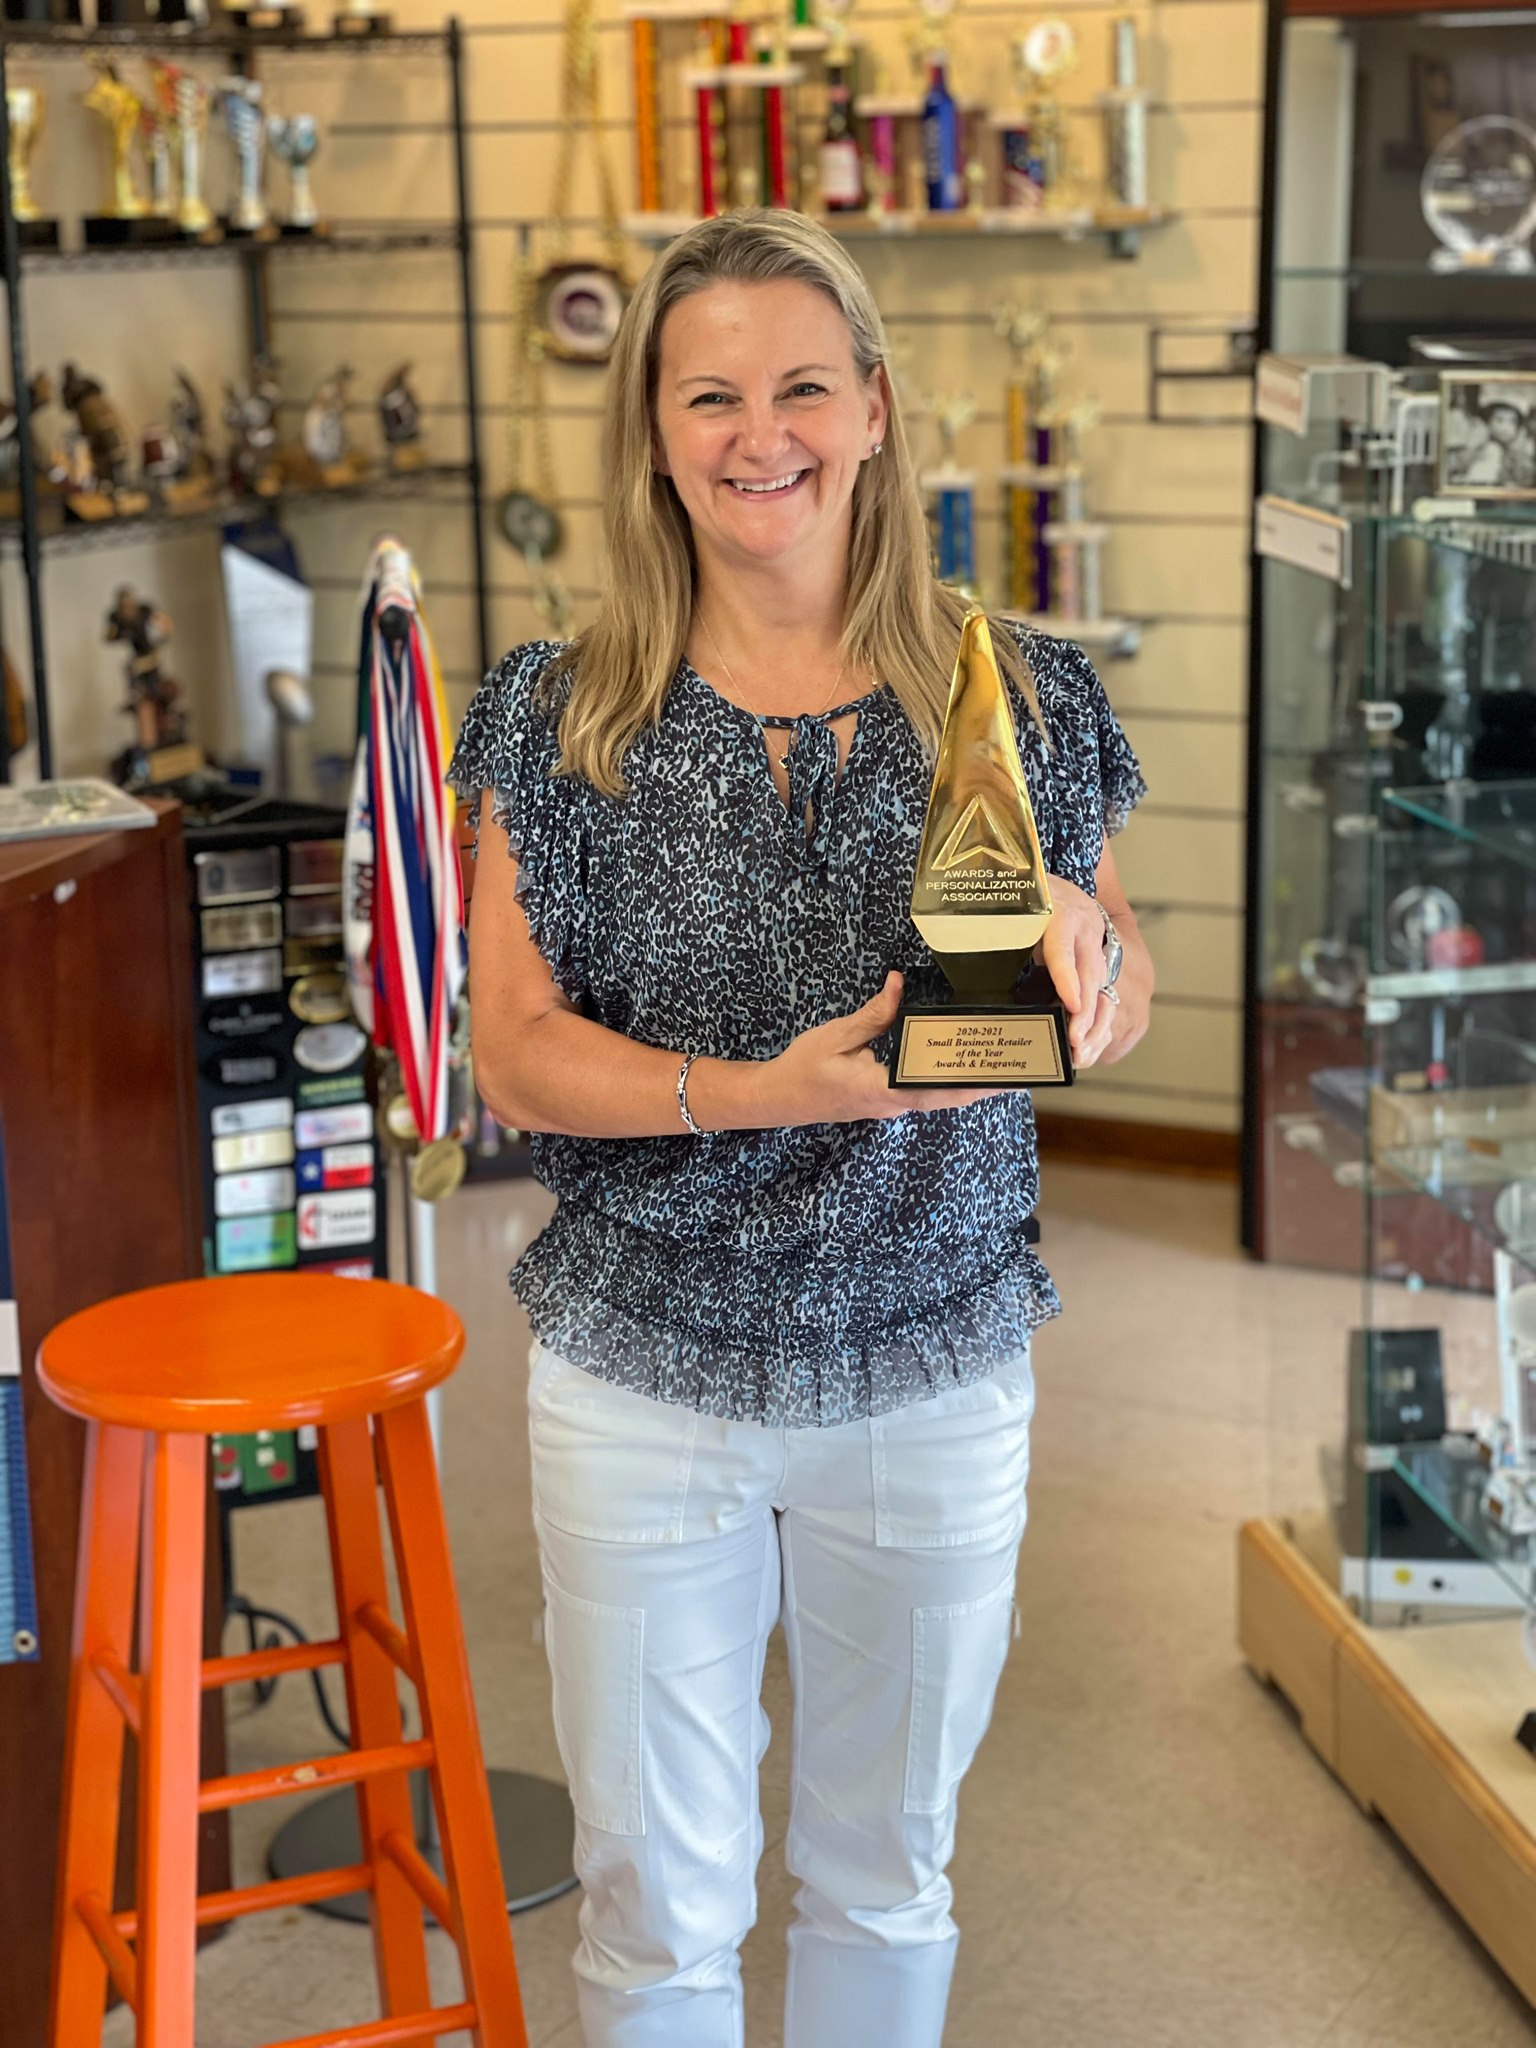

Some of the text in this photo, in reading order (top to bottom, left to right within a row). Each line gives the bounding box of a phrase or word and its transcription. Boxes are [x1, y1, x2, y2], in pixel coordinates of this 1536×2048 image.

[944, 869, 1017, 878] AWARDS and
[926, 880, 1036, 890] PERSONALIZATION
[941, 892, 1020, 902] ASSOCIATION
[956, 1027, 1003, 1036] 2020-2021
[926, 1038, 1033, 1047] Small Business Retailer
[955, 1049, 1004, 1058] of the Year
[933, 1060, 1027, 1069] Awards & Engraving
